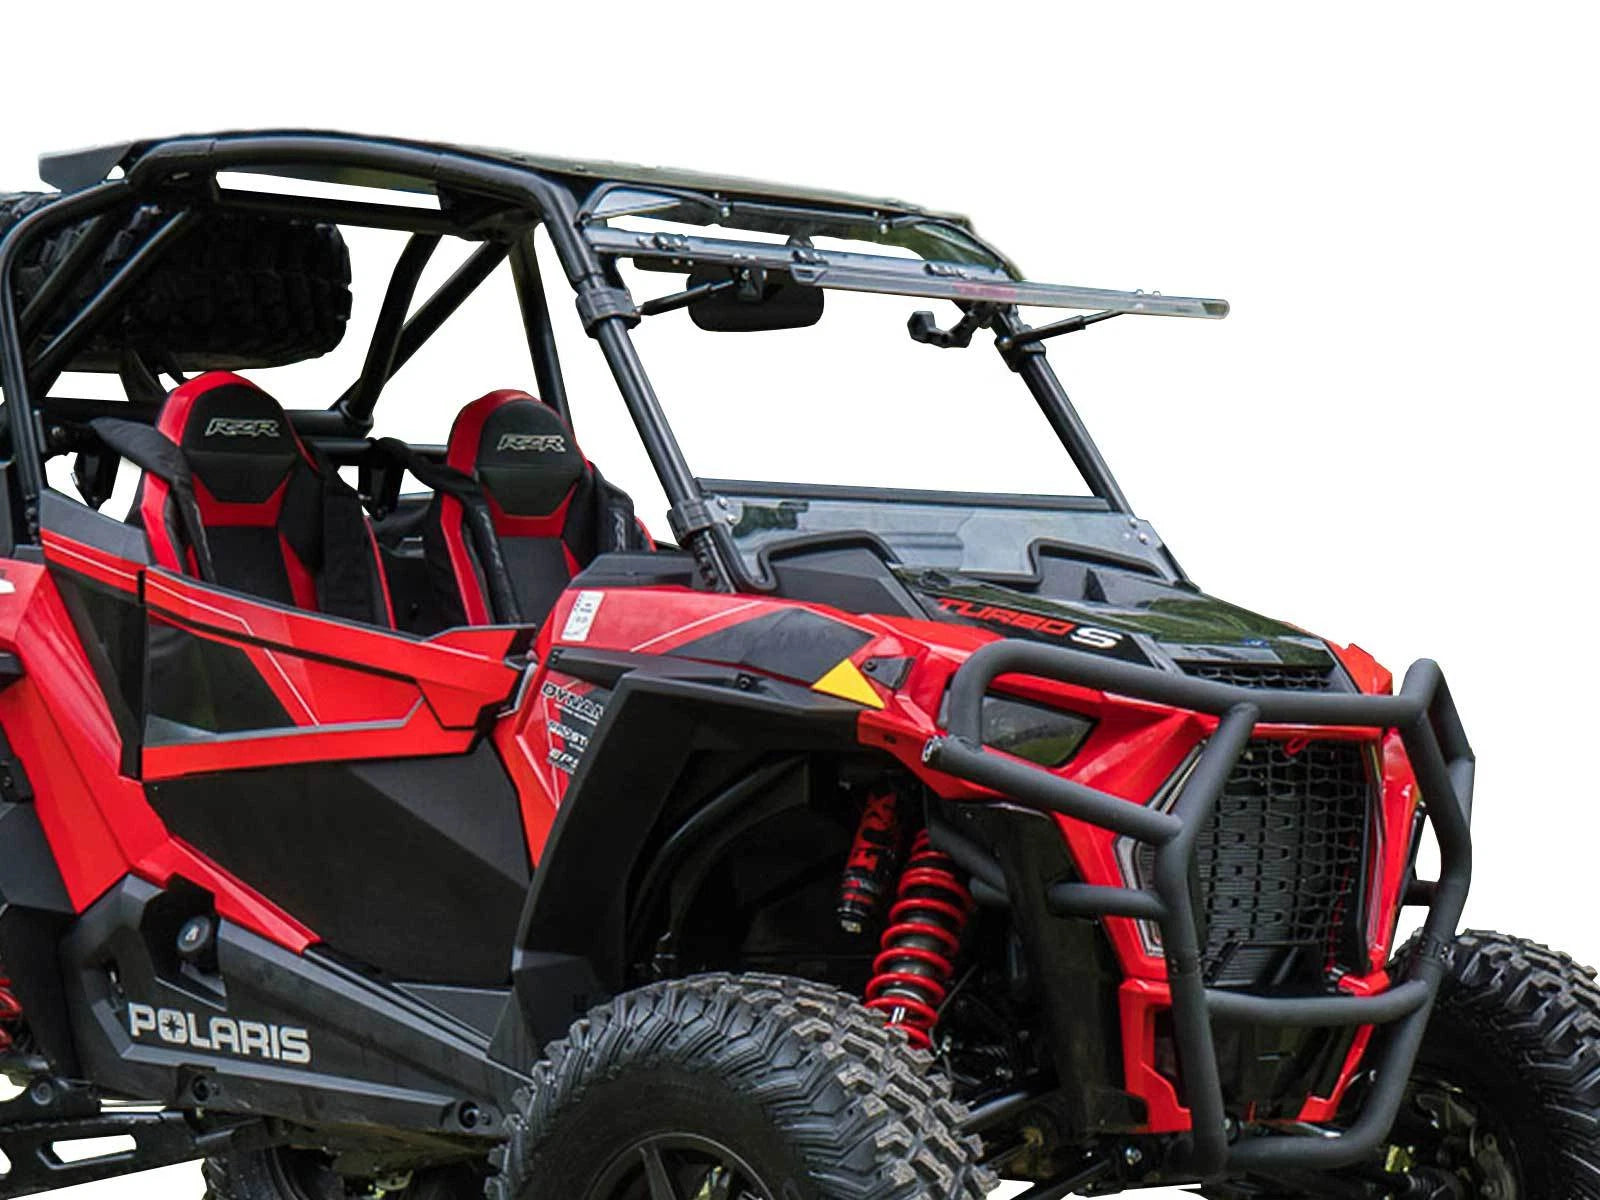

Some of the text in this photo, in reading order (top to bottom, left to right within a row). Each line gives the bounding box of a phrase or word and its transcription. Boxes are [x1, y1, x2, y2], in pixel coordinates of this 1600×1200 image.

[937, 597, 1123, 649] TURBO S
[128, 1002, 312, 1064] POLARIS
